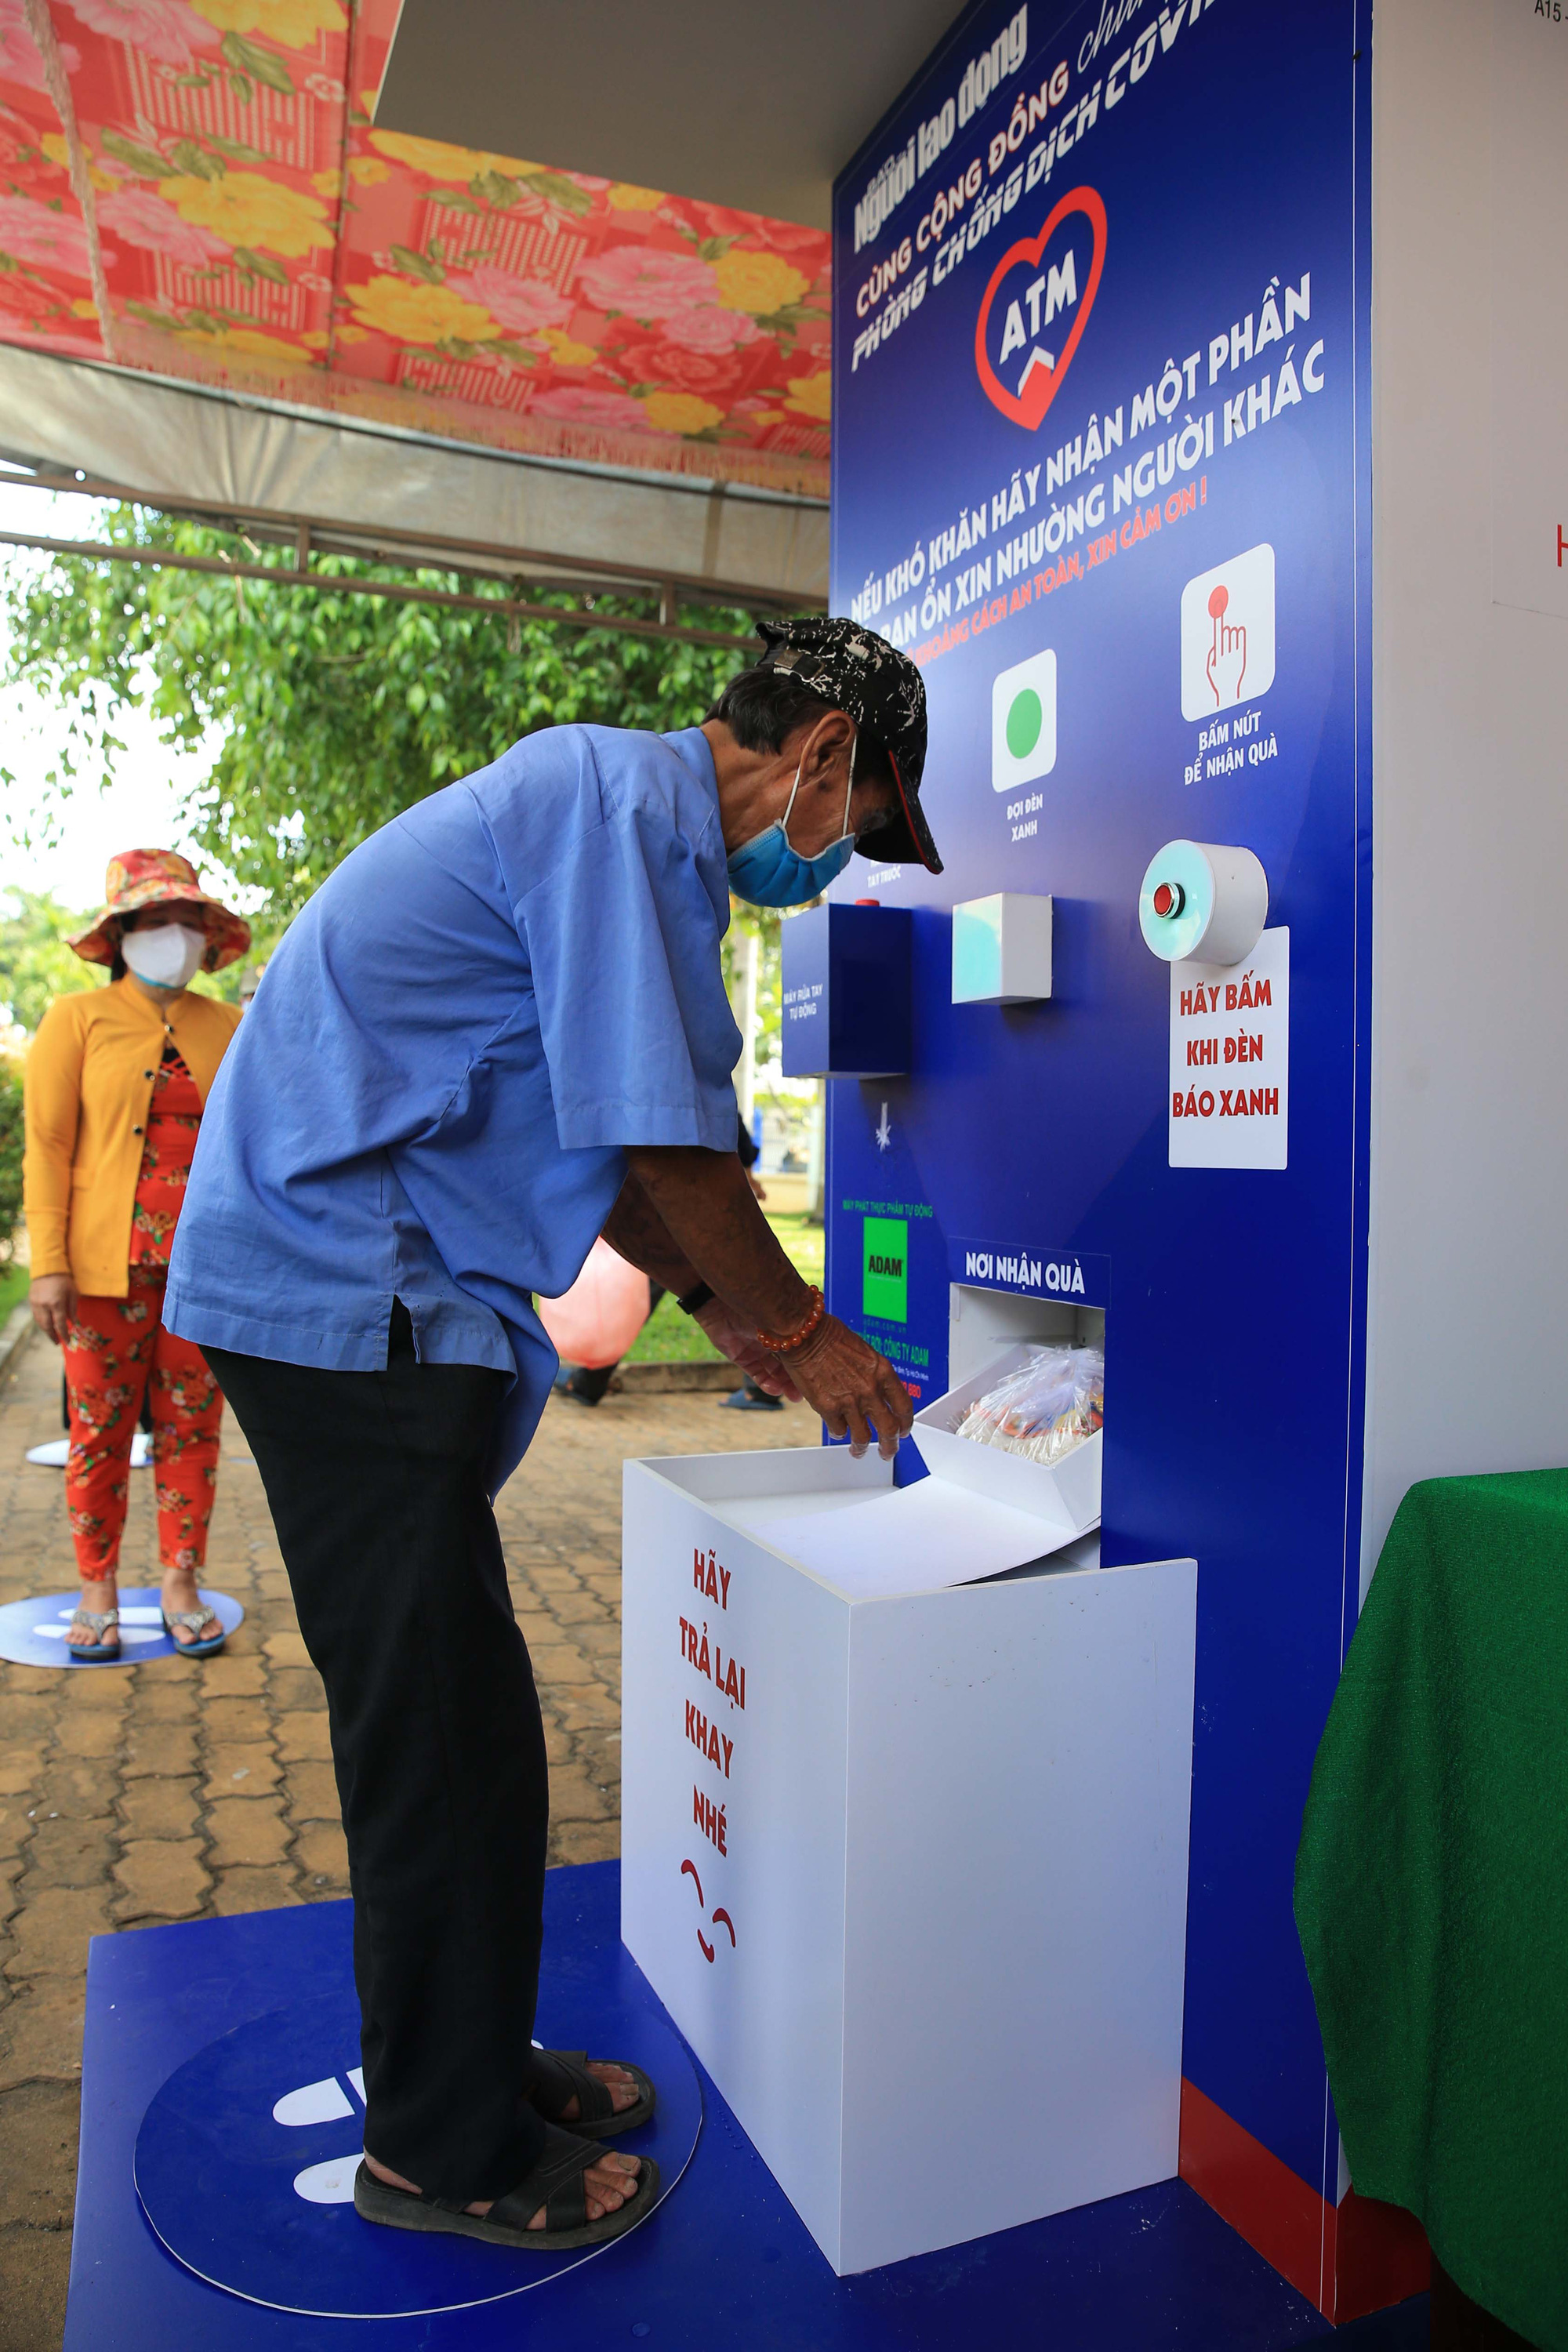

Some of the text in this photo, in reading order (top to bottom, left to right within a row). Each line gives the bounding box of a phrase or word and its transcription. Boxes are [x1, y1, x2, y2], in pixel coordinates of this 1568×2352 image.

[918, 97, 955, 179] lao
[958, 3, 1028, 129] động
[856, 237, 912, 318] CÙNG
[916, 158, 982, 252] CỘNG
[987, 60, 1069, 176] ĐỒNG
[851, 266, 928, 373] PHÒNG
[932, 162, 1025, 287] CHỐNG
[1025, 78, 1102, 194] DỊCH
[1000, 249, 1077, 365] ATM
[851, 271, 1310, 624] NẾU KHÓ KHĂN HÃY NHẬN MỘT PHẦN
[920, 576, 951, 631] ỔN
[954, 555, 992, 612] XIN
[996, 483, 1105, 586] NHƯỜNG
[1112, 411, 1214, 515] NGƯỜI
[1223, 338, 1325, 448] KHÁC
[971, 594, 1007, 636] CÁCH
[1009, 580, 1032, 615] AN
[1033, 551, 1084, 600] TOÀN,
[1087, 529, 1117, 571] XIN
[1120, 503, 1161, 549] CẢM
[1184, 732, 1278, 786] ĐỂ NHẬN QUÀ
[1199, 709, 1261, 752] BẤM NÚT
[1011, 819, 1038, 842] XANH
[1025, 792, 1044, 814] ĐÈN
[1180, 970, 1272, 1016] HÃY BẤM
[1187, 1028, 1263, 1066] KHI ĐÈN
[1172, 1084, 1278, 1117] BÁO XANH
[869, 1255, 902, 1277] ADAM
[966, 1251, 1086, 1294] NƠI NHẬN QUÀ
[694, 1548, 731, 1611] HÃY
[679, 1615, 746, 1711] TRẢ LẠI
[685, 1698, 734, 1780] KHAY
[693, 1784, 727, 1859] NHÉ
